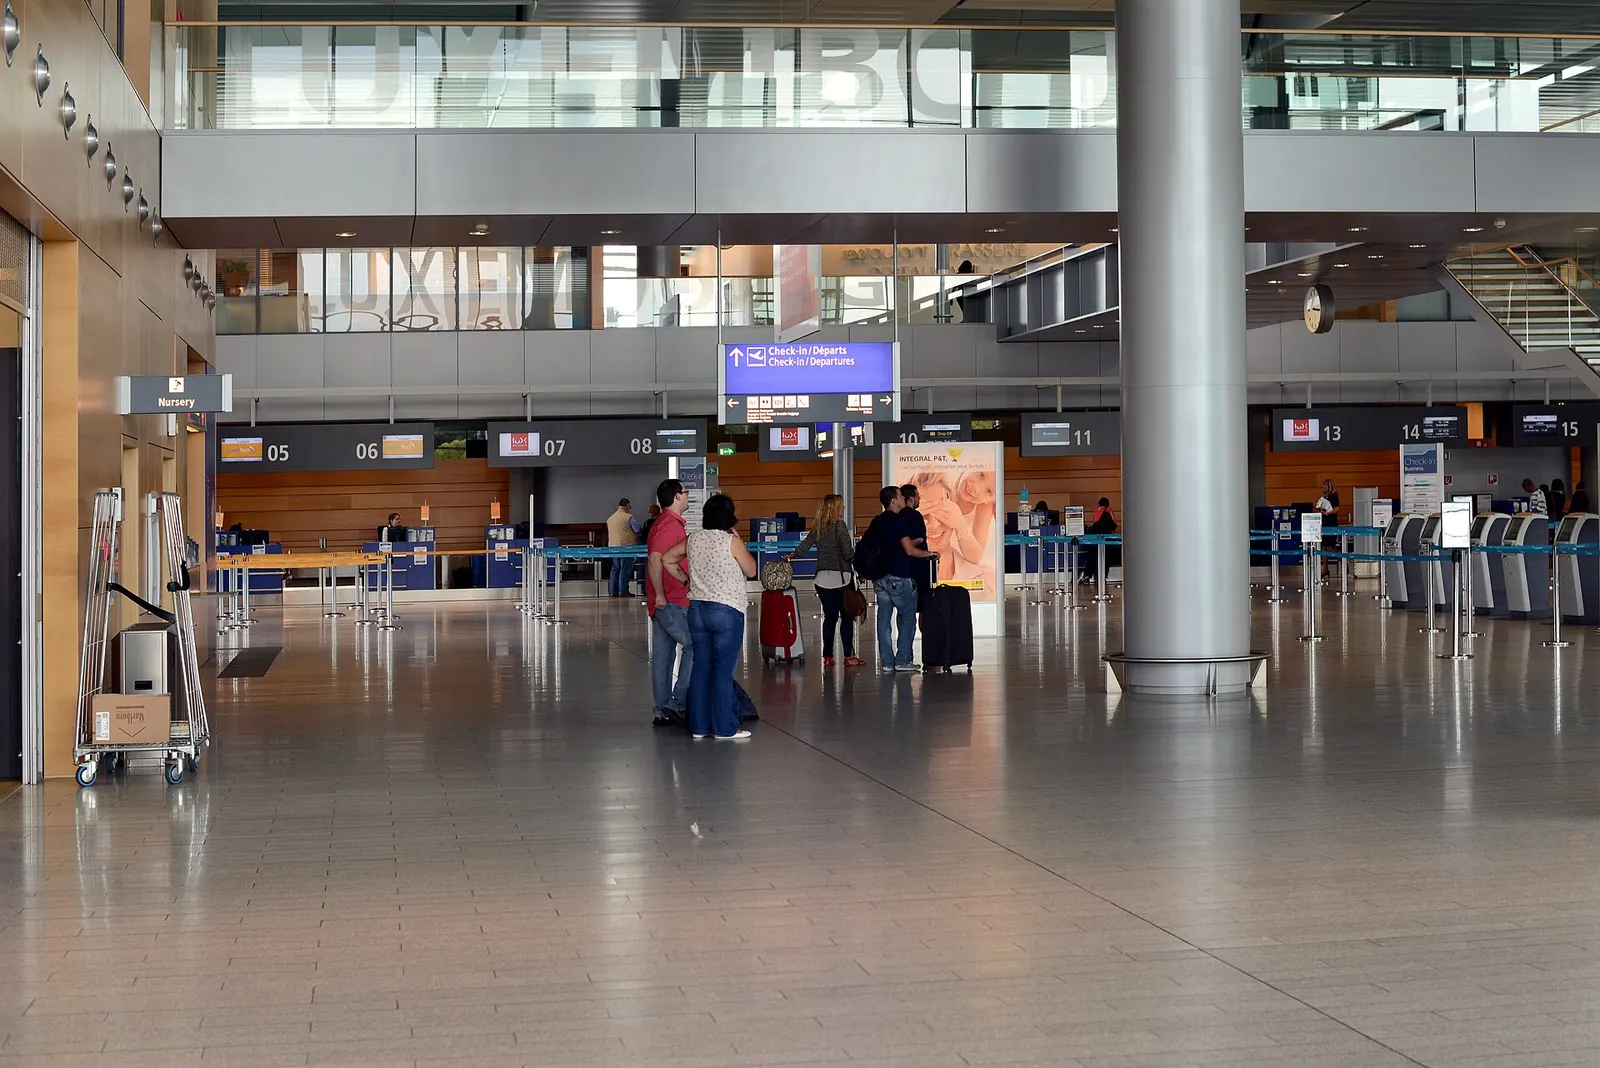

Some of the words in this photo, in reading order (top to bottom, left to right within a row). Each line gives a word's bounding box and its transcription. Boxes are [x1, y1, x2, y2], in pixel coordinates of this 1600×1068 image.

[158, 397, 195, 409] Nursery
[1323, 425, 1342, 441] 13
[1402, 424, 1420, 440] 14
[1561, 421, 1579, 437] 15
[899, 432, 919, 444] 10
[1074, 429, 1092, 446] 11
[267, 444, 290, 462] 05
[356, 442, 378, 459] 06
[544, 439, 566, 456] 07
[630, 437, 652, 455] 08
[1404, 457, 1436, 466] Check-in
[680, 471, 703, 481] Check-in
[115, 712, 145, 725] Marlboro
